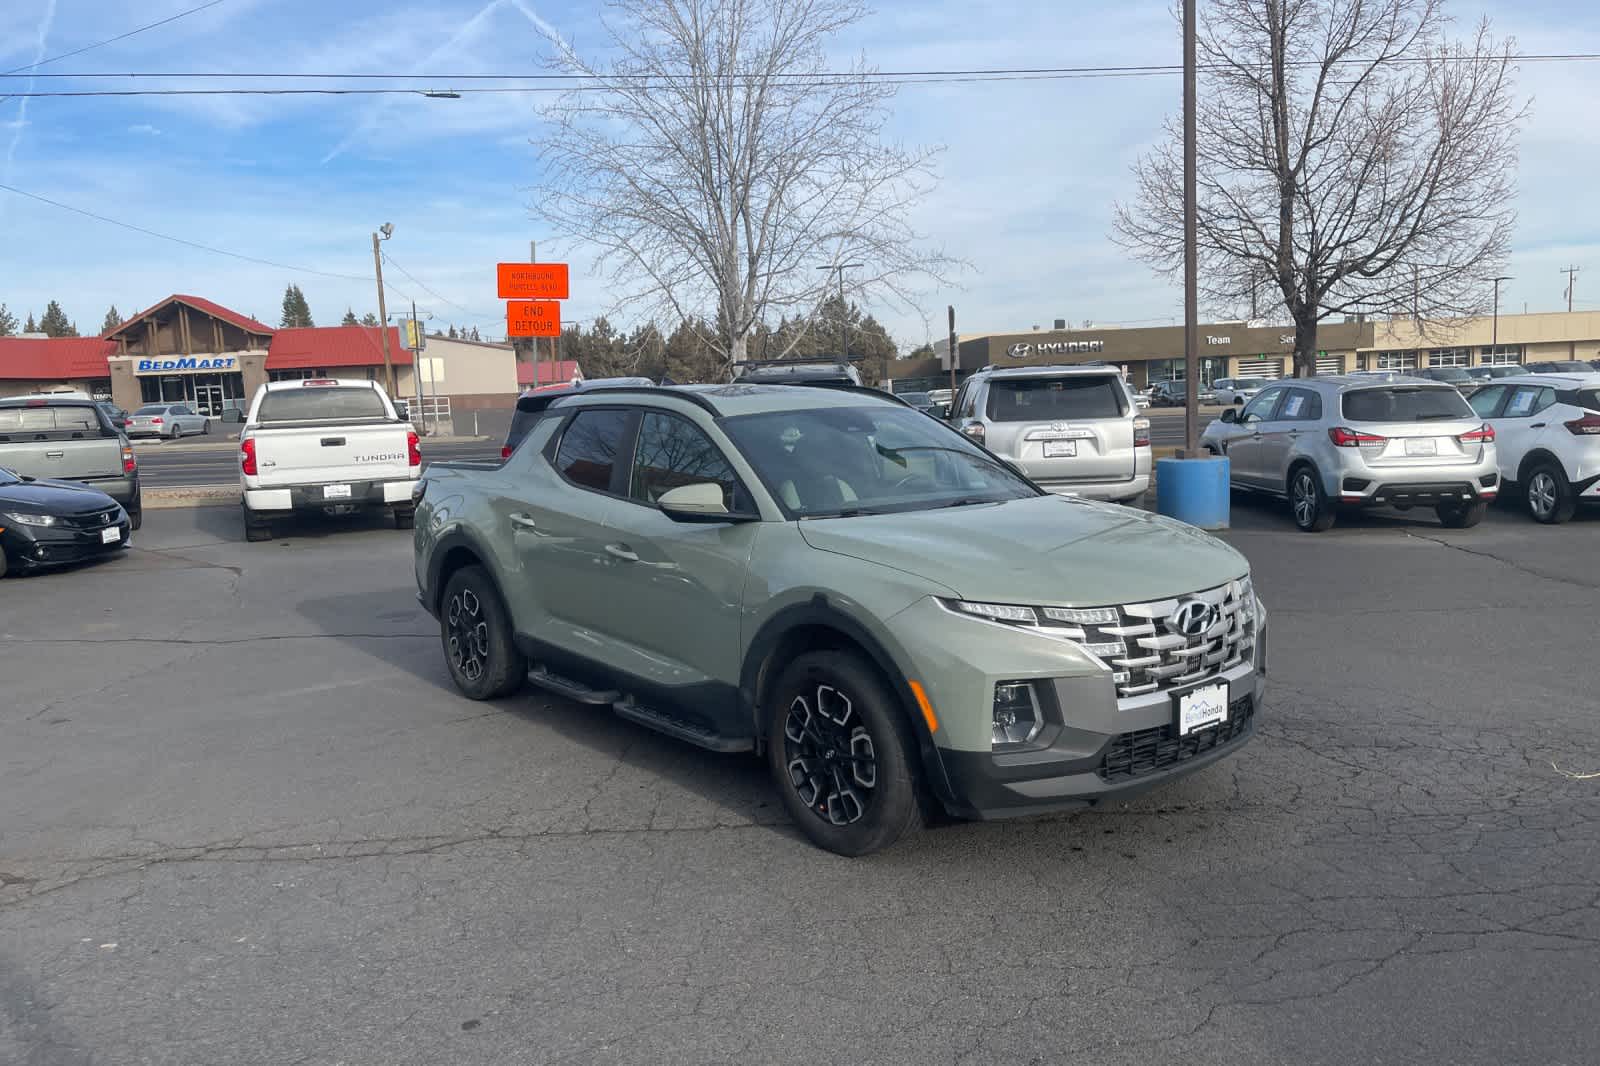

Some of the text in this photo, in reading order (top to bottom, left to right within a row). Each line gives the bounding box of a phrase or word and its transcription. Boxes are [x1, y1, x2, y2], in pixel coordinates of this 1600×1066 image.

[524, 306, 544, 316] END
[515, 321, 553, 331] DETOUR
[1206, 335, 1231, 344] Team
[1036, 340, 1104, 354] HYUNDAI
[353, 452, 405, 462] TUNDRA
